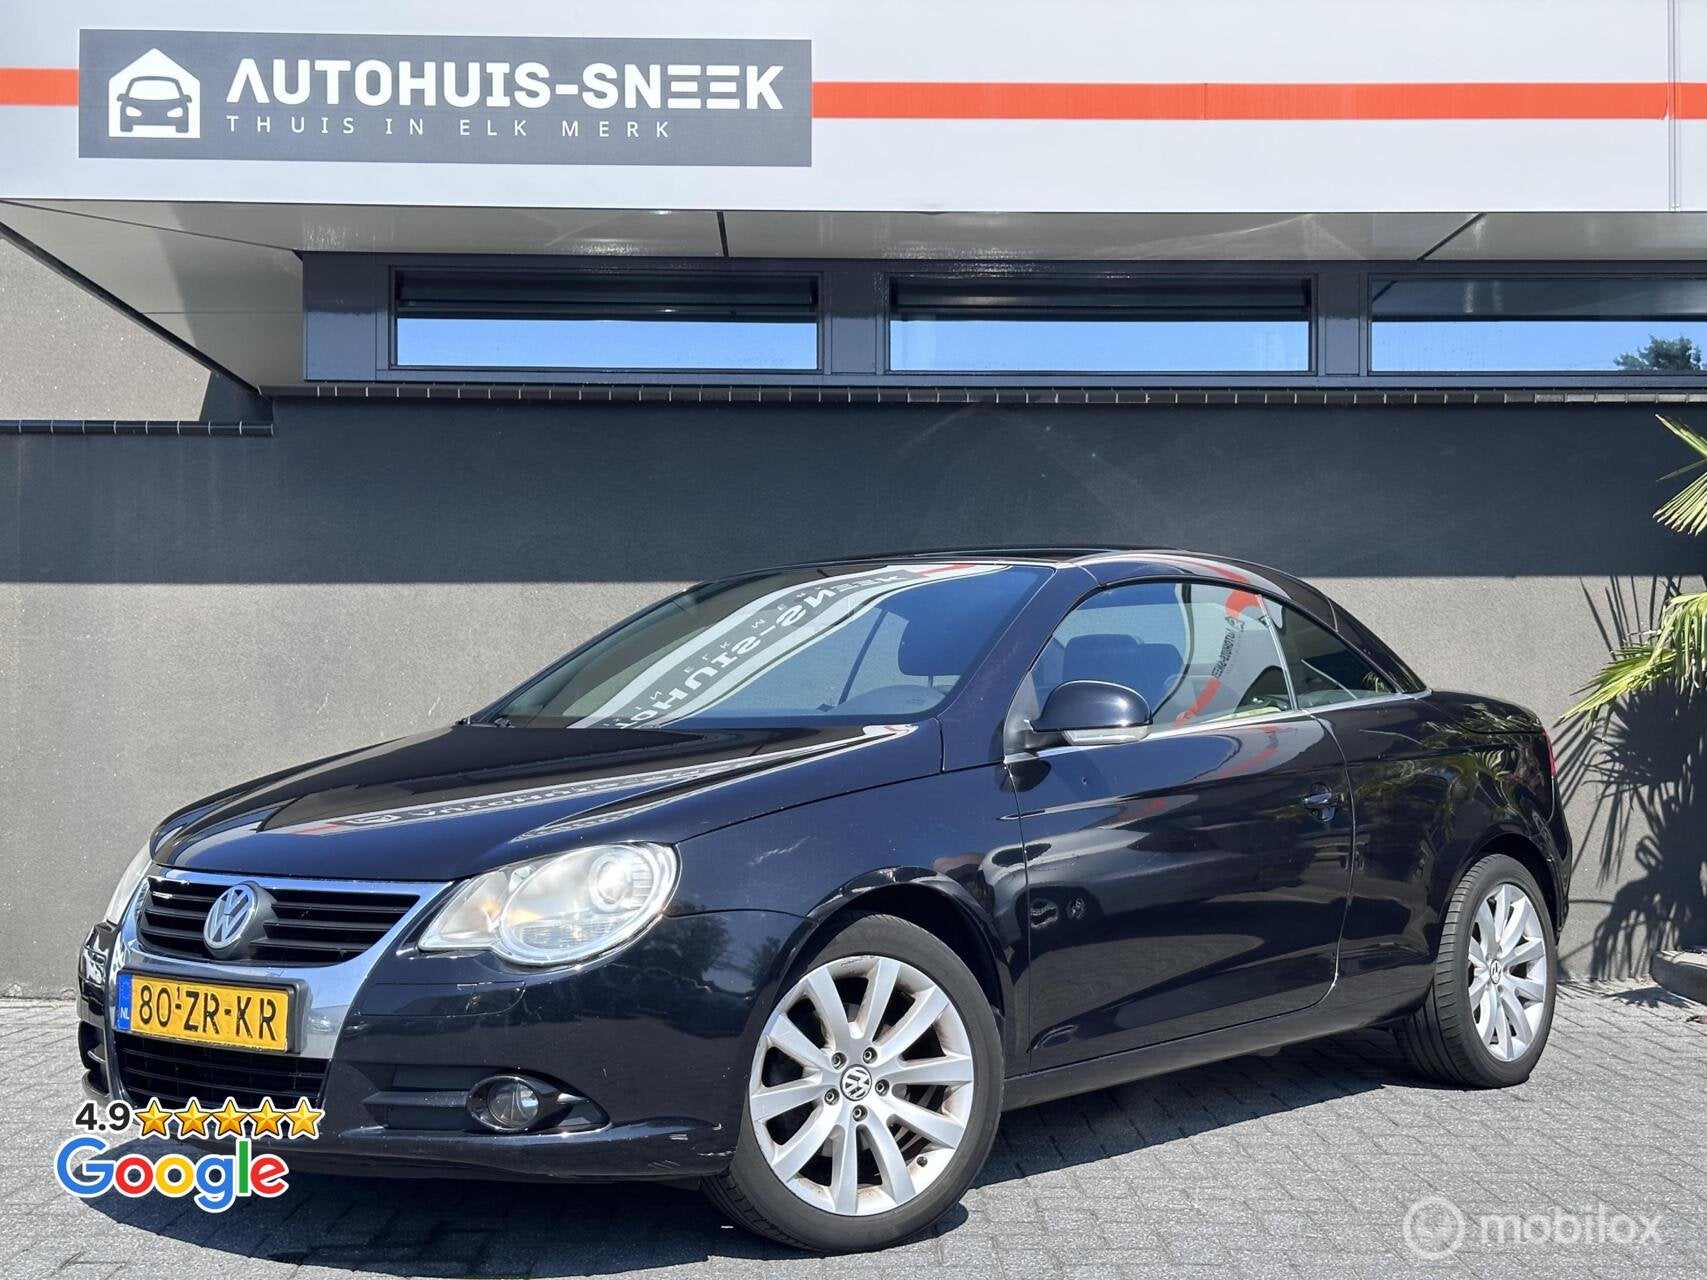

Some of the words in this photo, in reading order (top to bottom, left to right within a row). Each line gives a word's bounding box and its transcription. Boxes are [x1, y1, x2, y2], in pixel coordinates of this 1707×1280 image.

[225, 58, 785, 110] AUTOHUIS-SNEEK
[226, 115, 355, 134] THUIS
[385, 117, 424, 135] IN
[459, 119, 527, 136] ELK
[561, 120, 669, 138] MERK
[120, 1007, 130, 1020] NL
[139, 984, 277, 1041] 80-ZR-KR
